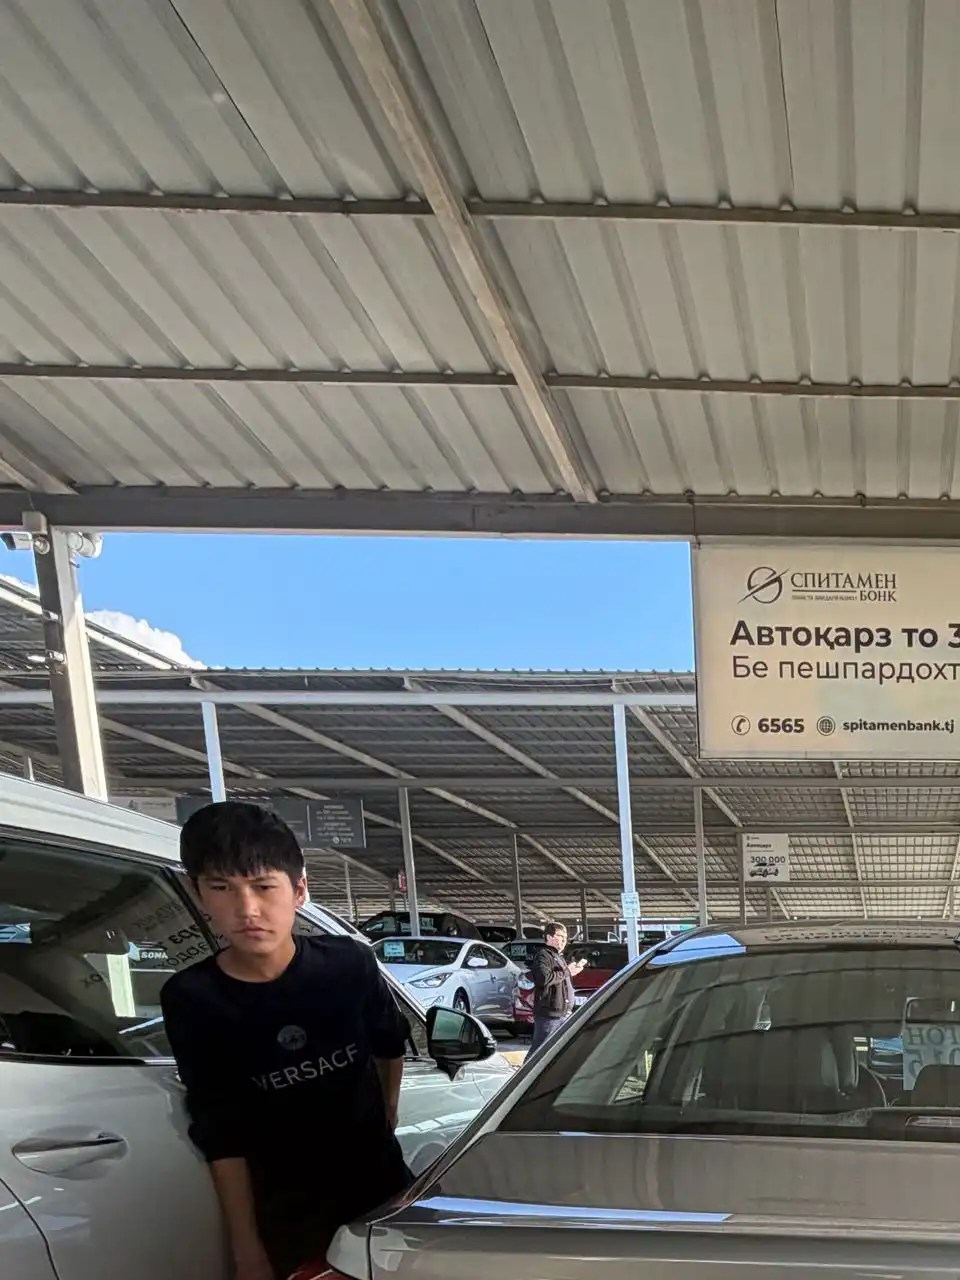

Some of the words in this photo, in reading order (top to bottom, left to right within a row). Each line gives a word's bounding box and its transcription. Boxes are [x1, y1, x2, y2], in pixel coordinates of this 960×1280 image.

[790, 572, 897, 590] СПИТАМЕН
[859, 590, 897, 603] БОНК
[730, 620, 892, 654] Автоқарз
[901, 628, 939, 648] то
[732, 655, 769, 679] Бе
[757, 717, 805, 734] 6565
[842, 718, 955, 735] spitamenbank.tj
